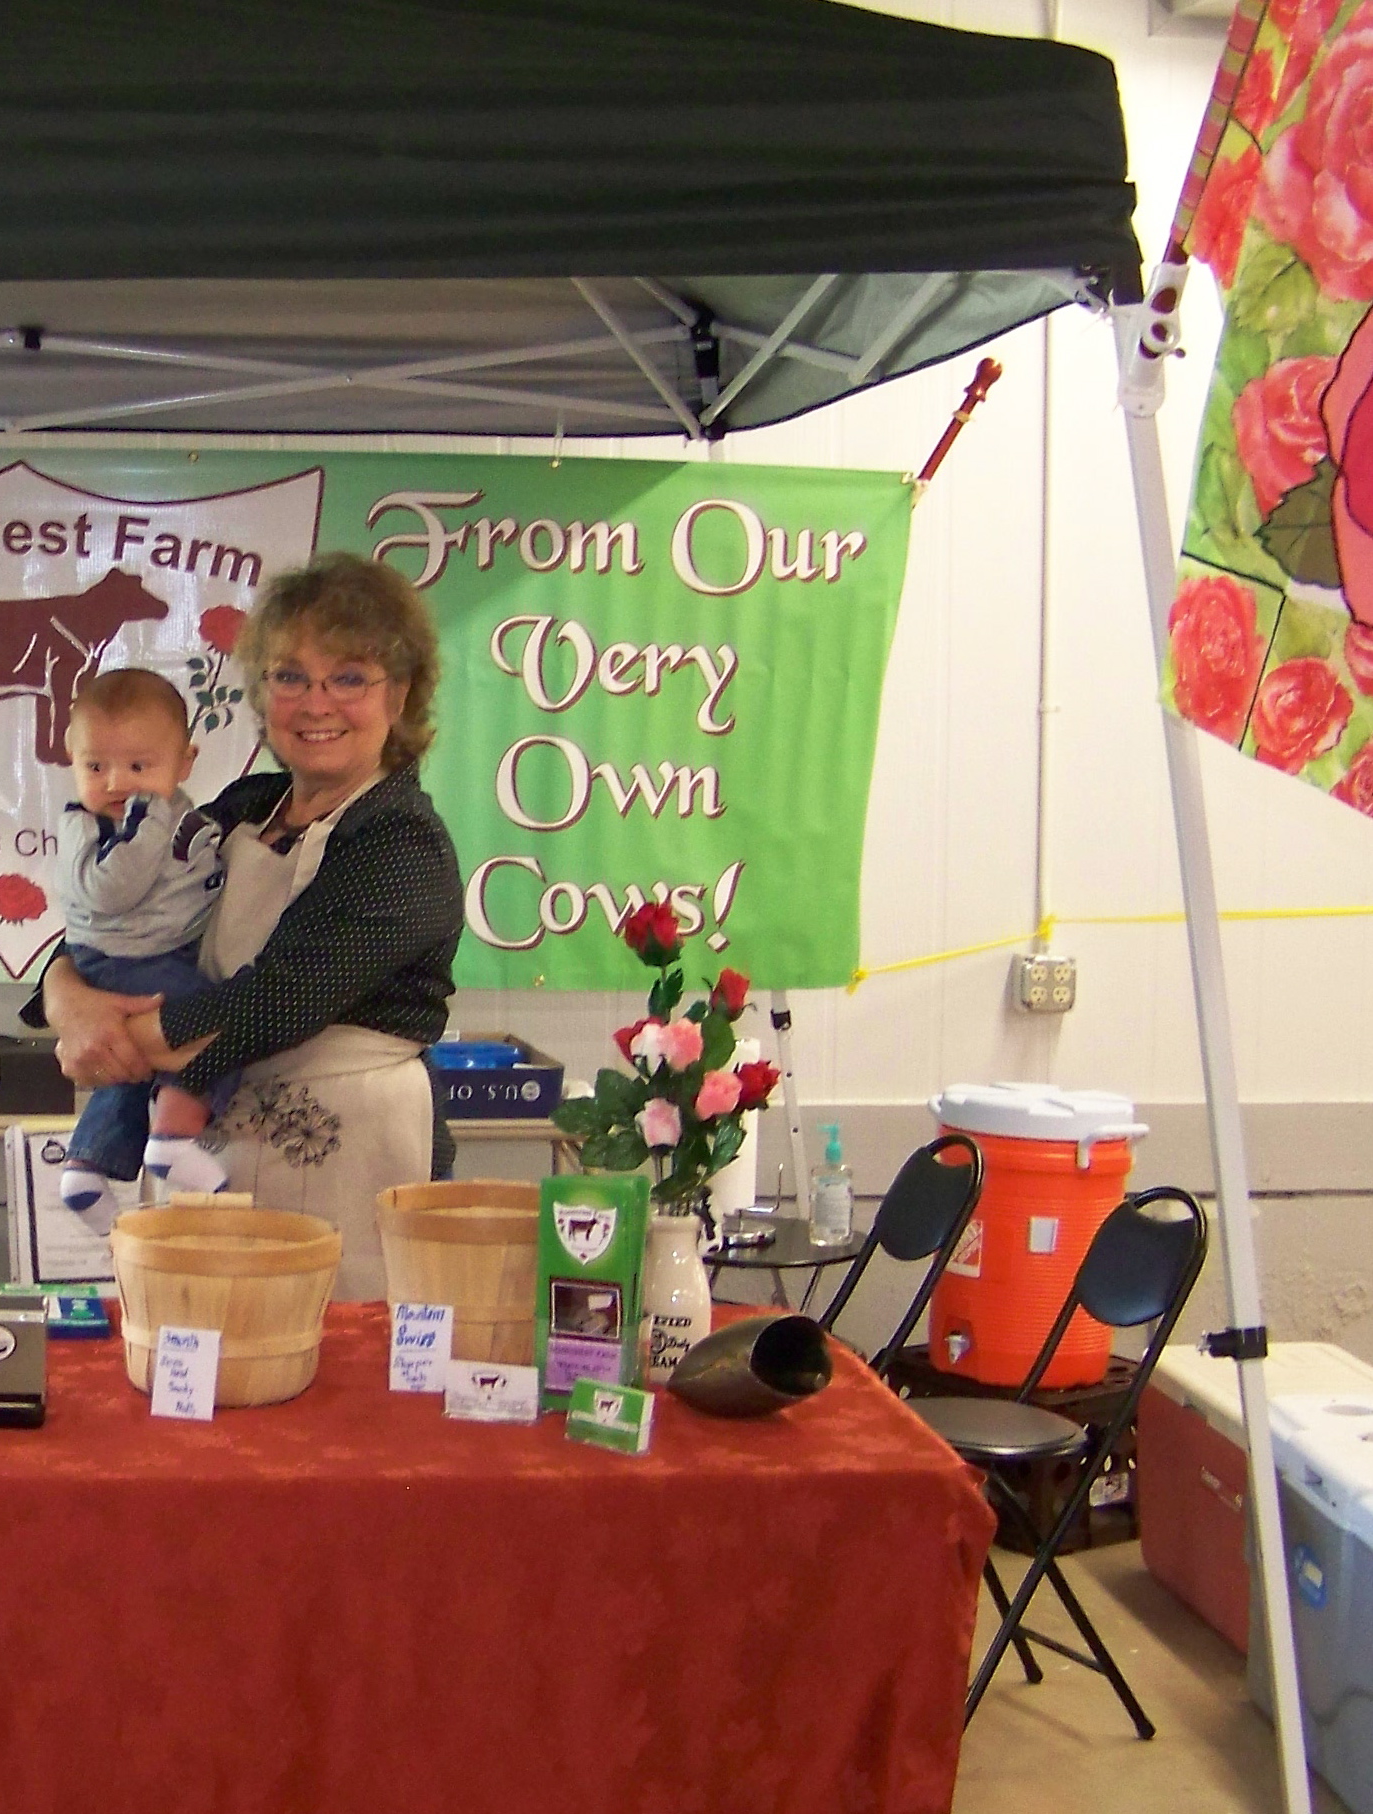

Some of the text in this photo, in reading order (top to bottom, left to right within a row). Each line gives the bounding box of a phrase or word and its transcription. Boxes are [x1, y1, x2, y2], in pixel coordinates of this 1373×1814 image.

[113, 515, 263, 587] Farm
[367, 490, 868, 596] From Our
[490, 614, 739, 735] Very
[495, 735, 728, 832] Own
[14, 828, 58, 857] Ch
[465, 855, 747, 952] Cows!
